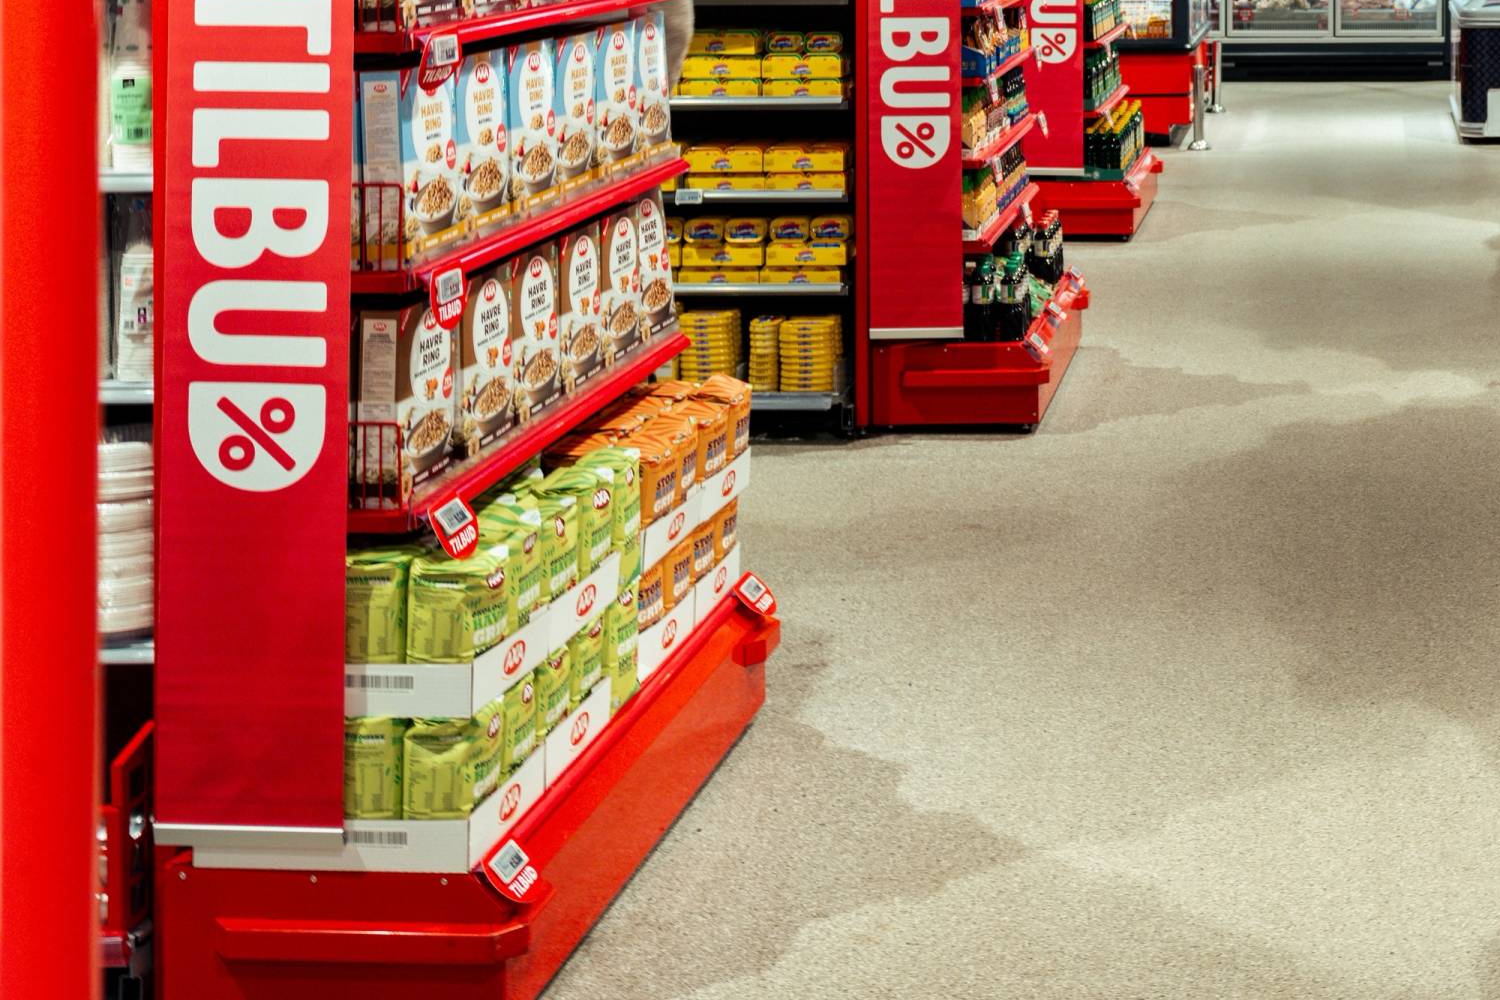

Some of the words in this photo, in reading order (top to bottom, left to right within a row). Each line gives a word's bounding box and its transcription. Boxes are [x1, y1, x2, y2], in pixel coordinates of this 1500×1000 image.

[422, 65, 452, 84] TILBUD
[419, 102, 445, 117] HAVRE
[423, 116, 442, 131] RING
[438, 301, 464, 322] TILBUD
[479, 303, 502, 324] HAVRE
[482, 318, 501, 336] RING
[418, 331, 445, 353] HAVRE
[421, 347, 441, 367] RING
[448, 525, 478, 555] TILBUD
[508, 864, 539, 899] TILBUD
